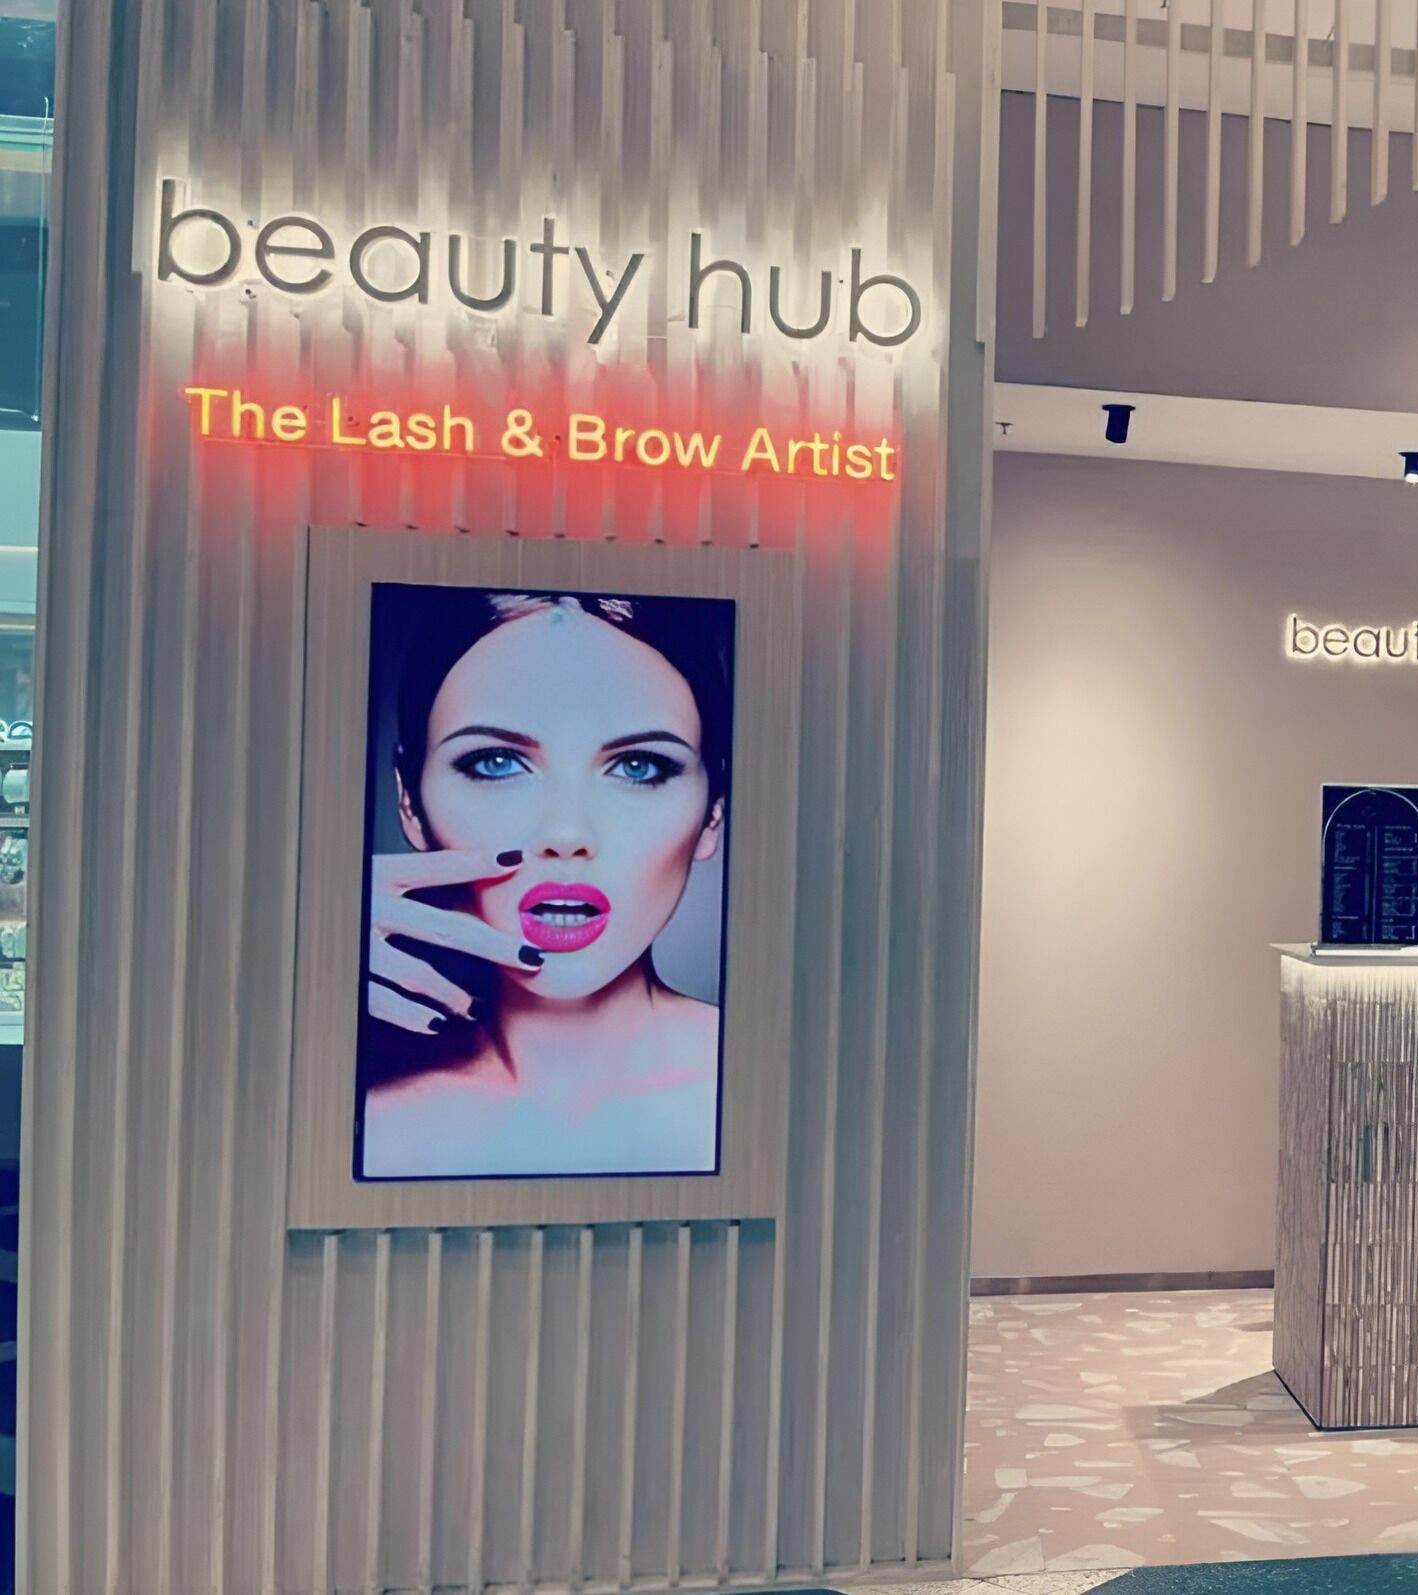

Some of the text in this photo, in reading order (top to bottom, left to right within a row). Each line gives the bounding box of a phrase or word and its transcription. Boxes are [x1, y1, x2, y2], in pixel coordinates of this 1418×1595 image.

[157, 178, 922, 347] beauty hub
[185, 385, 896, 482] The Lash & Brow Artist
